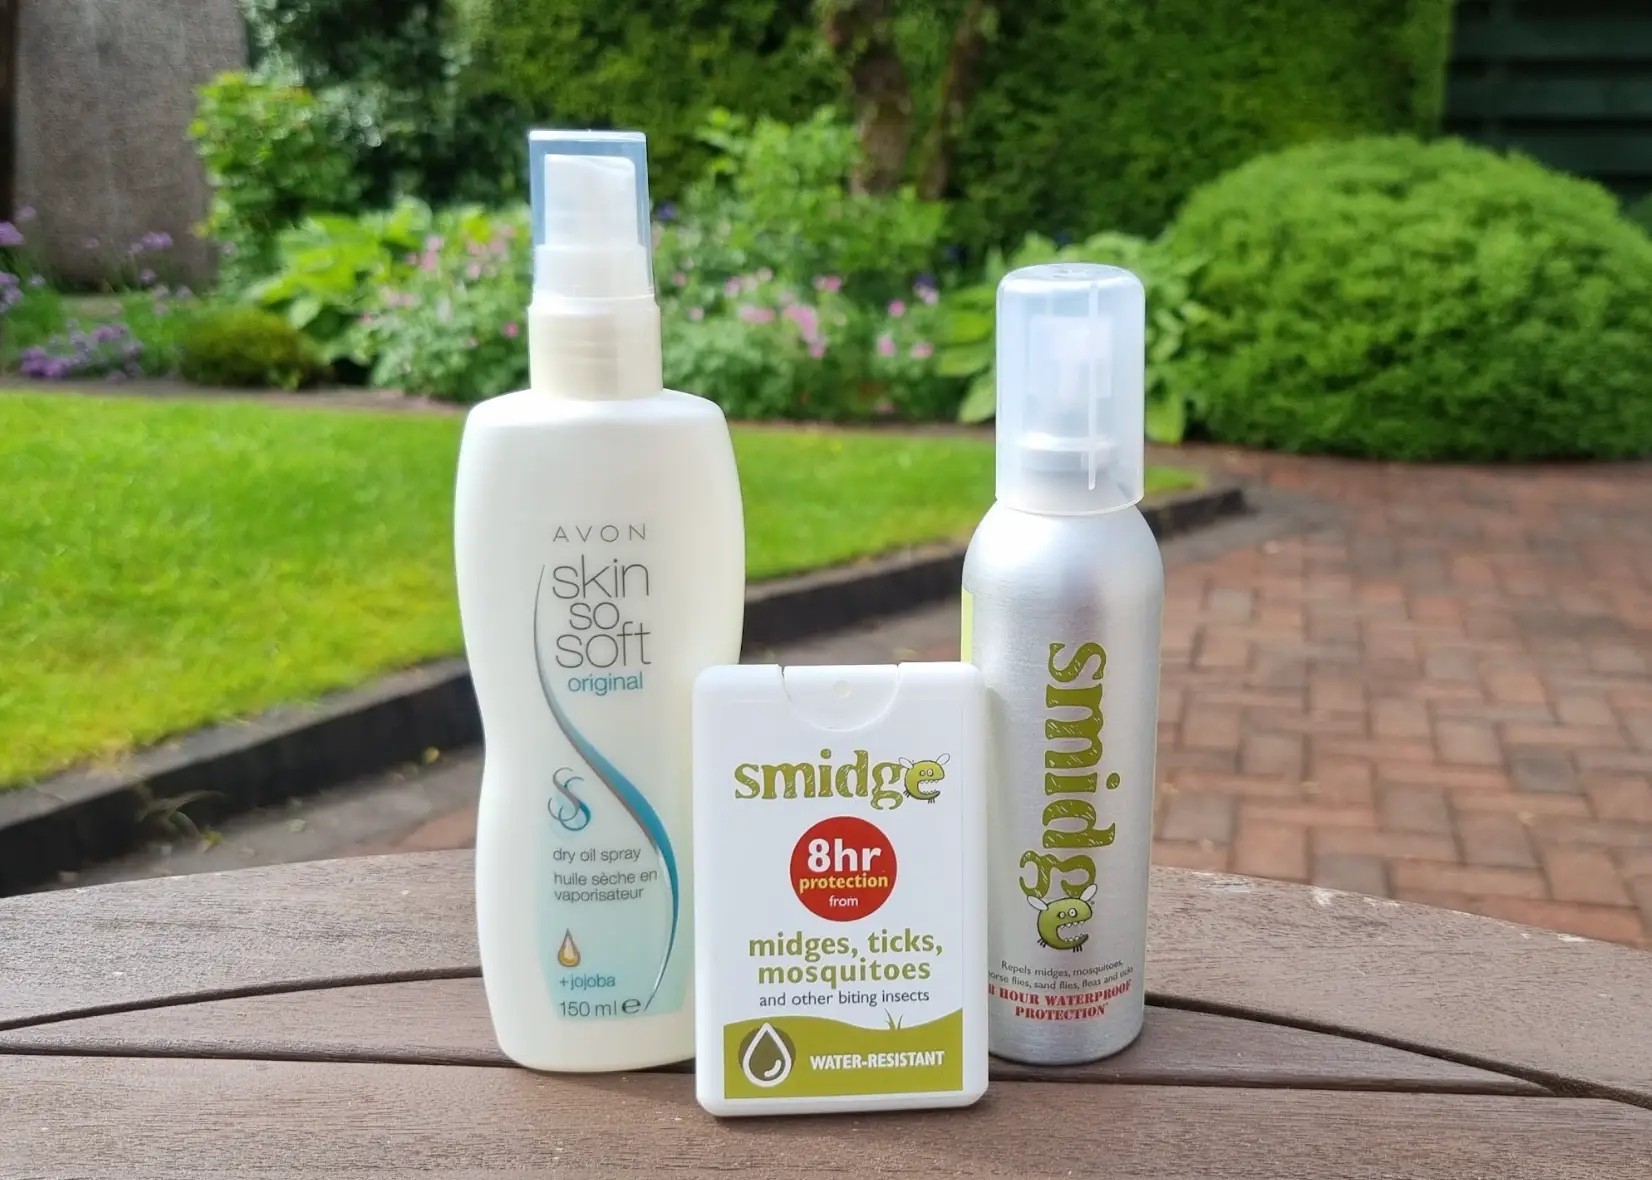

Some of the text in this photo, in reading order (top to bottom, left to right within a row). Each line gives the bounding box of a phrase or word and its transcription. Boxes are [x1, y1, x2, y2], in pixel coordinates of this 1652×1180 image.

[552, 524, 646, 543] AVON
[552, 554, 650, 599] skin
[569, 602, 620, 630] so
[555, 621, 652, 669] soft
[567, 672, 643, 696] original
[734, 748, 951, 811] smidge
[1019, 641, 1121, 952] smidge
[553, 847, 642, 864] dry oil spray
[807, 838, 882, 873] 8hr
[554, 869, 658, 886] huile sèche en
[799, 872, 889, 893] protection
[554, 886, 645, 904] vaporisateur
[828, 895, 859, 908] from
[749, 928, 943, 962] midges, ticks,
[758, 957, 931, 989] mosquitoes
[1001, 960, 1032, 976] Repels
[1034, 966, 1071, 980] midges,
[559, 973, 616, 988] +jojoba
[1011, 976, 1032, 989] flies,
[1033, 982, 1056, 990] sand
[1059, 981, 1080, 990] flies,
[1082, 978, 1101, 988] fleas
[1103, 972, 1118, 984] and
[759, 990, 930, 1006] and other biting insects
[1000, 987, 1040, 1005] HOUR
[1044, 979, 1132, 1006] WATERPROOF
[560, 1001, 591, 1017] 150
[594, 1001, 617, 1016] ml
[810, 1051, 945, 1070] WATER-RESISTANT
